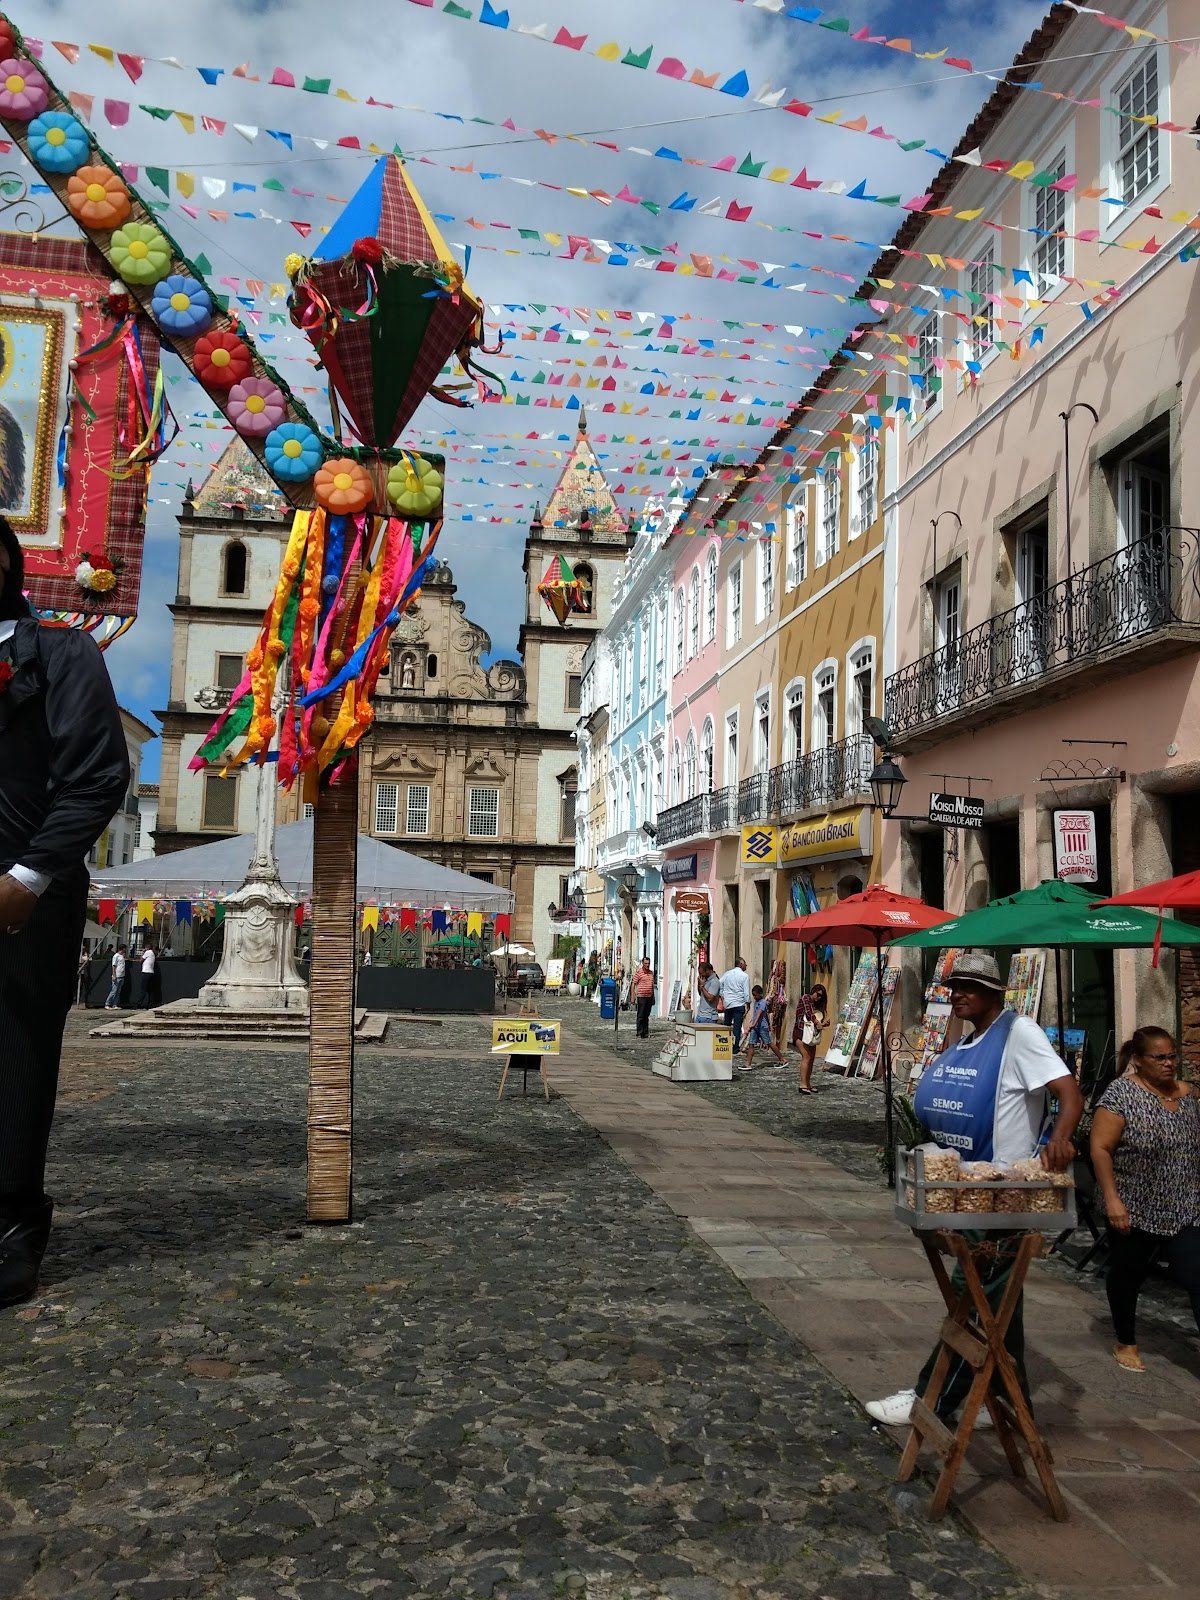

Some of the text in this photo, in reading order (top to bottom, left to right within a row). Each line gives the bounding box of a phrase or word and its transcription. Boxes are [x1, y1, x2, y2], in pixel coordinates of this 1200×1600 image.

[930, 813, 982, 827] GALERIA DE ARTE
[792, 822, 855, 848] BANCO DO BRASIL
[1060, 853, 1095, 866] COLISEU
[1058, 866, 1096, 880] RESTAURANTE
[497, 1032, 528, 1043] AQUI
[945, 1066, 978, 1077] SALVADOR
[932, 1097, 963, 1110] SEMOP
